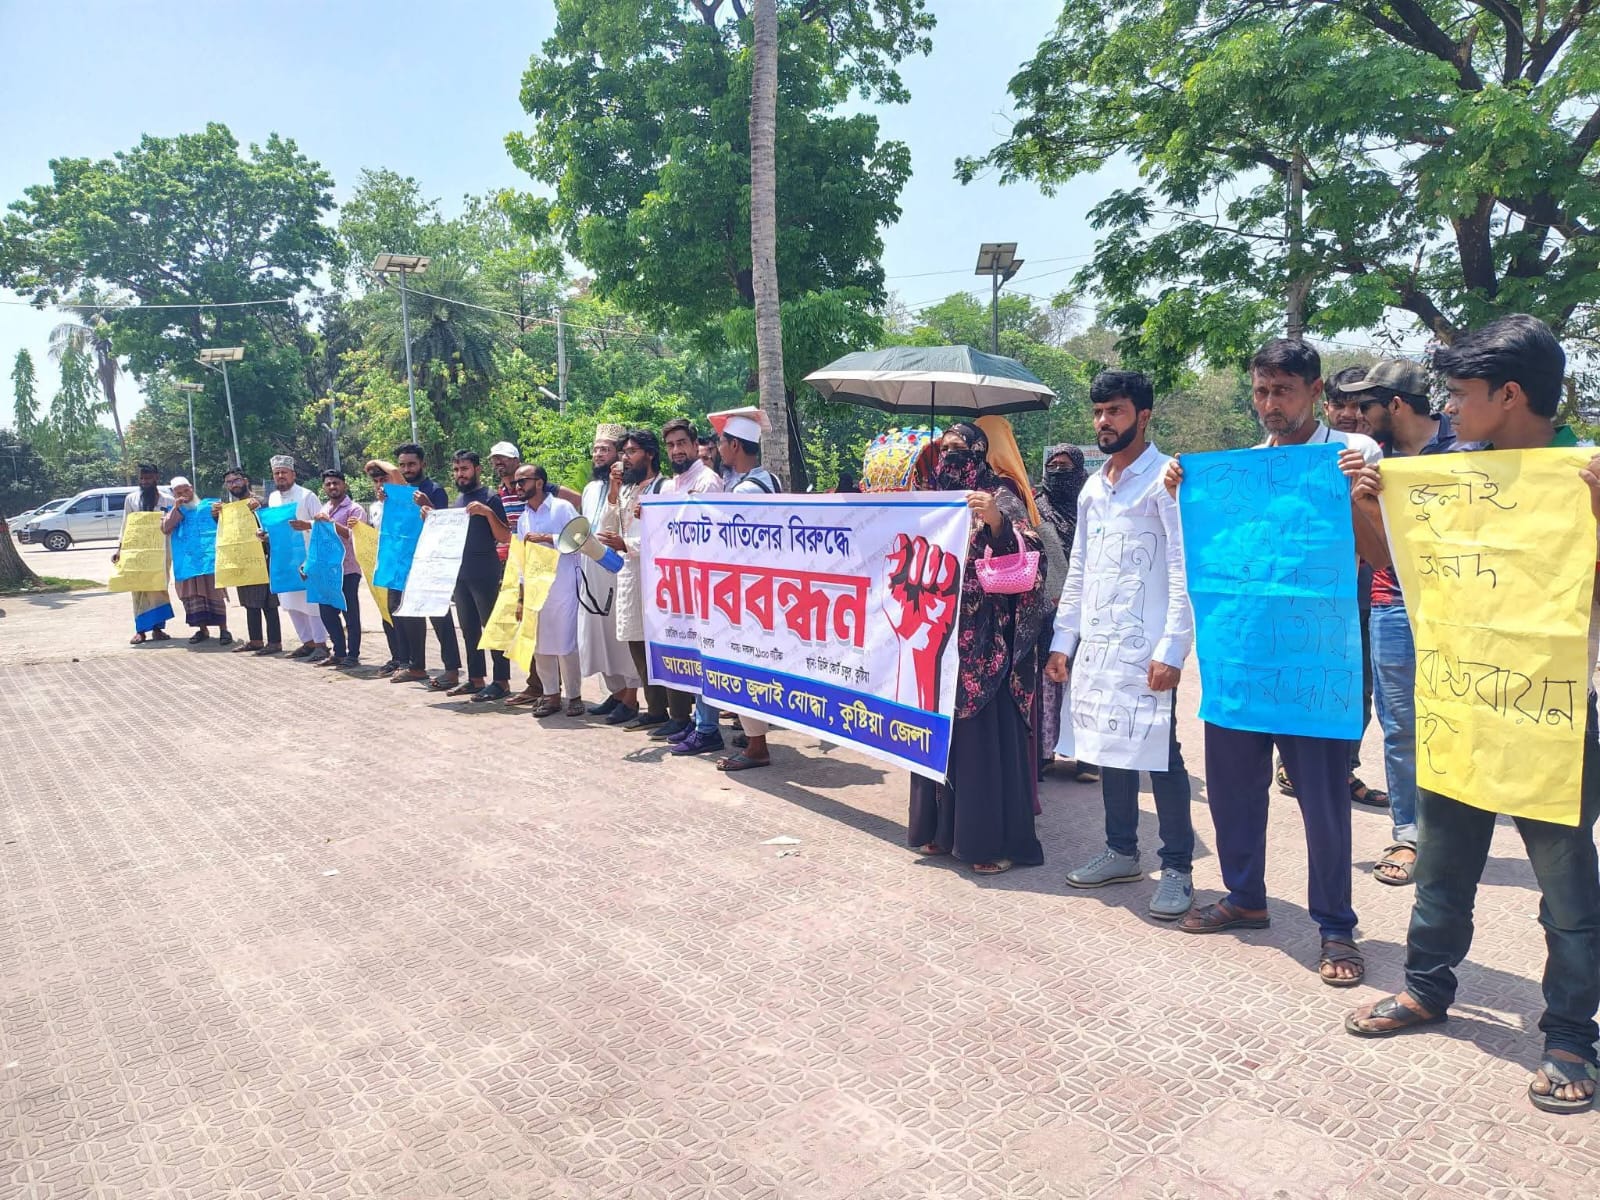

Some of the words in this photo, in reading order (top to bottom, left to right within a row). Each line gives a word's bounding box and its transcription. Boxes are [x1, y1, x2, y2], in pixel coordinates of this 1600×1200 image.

[667, 513, 713, 545] গণভোট
[716, 514, 783, 551] বাতিলের
[787, 515, 853, 557] বিরুদ্ধে
[1408, 470, 1517, 538] জুলাই
[654, 558, 872, 648] মানববন্ধন
[1418, 553, 1497, 589] সনদ
[705, 669, 743, 694] আহত
[746, 674, 785, 708] জুলাই
[839, 698, 884, 739] কুষ্টিয়া
[889, 718, 933, 754] জেলা
[1415, 696, 1459, 775] াই
